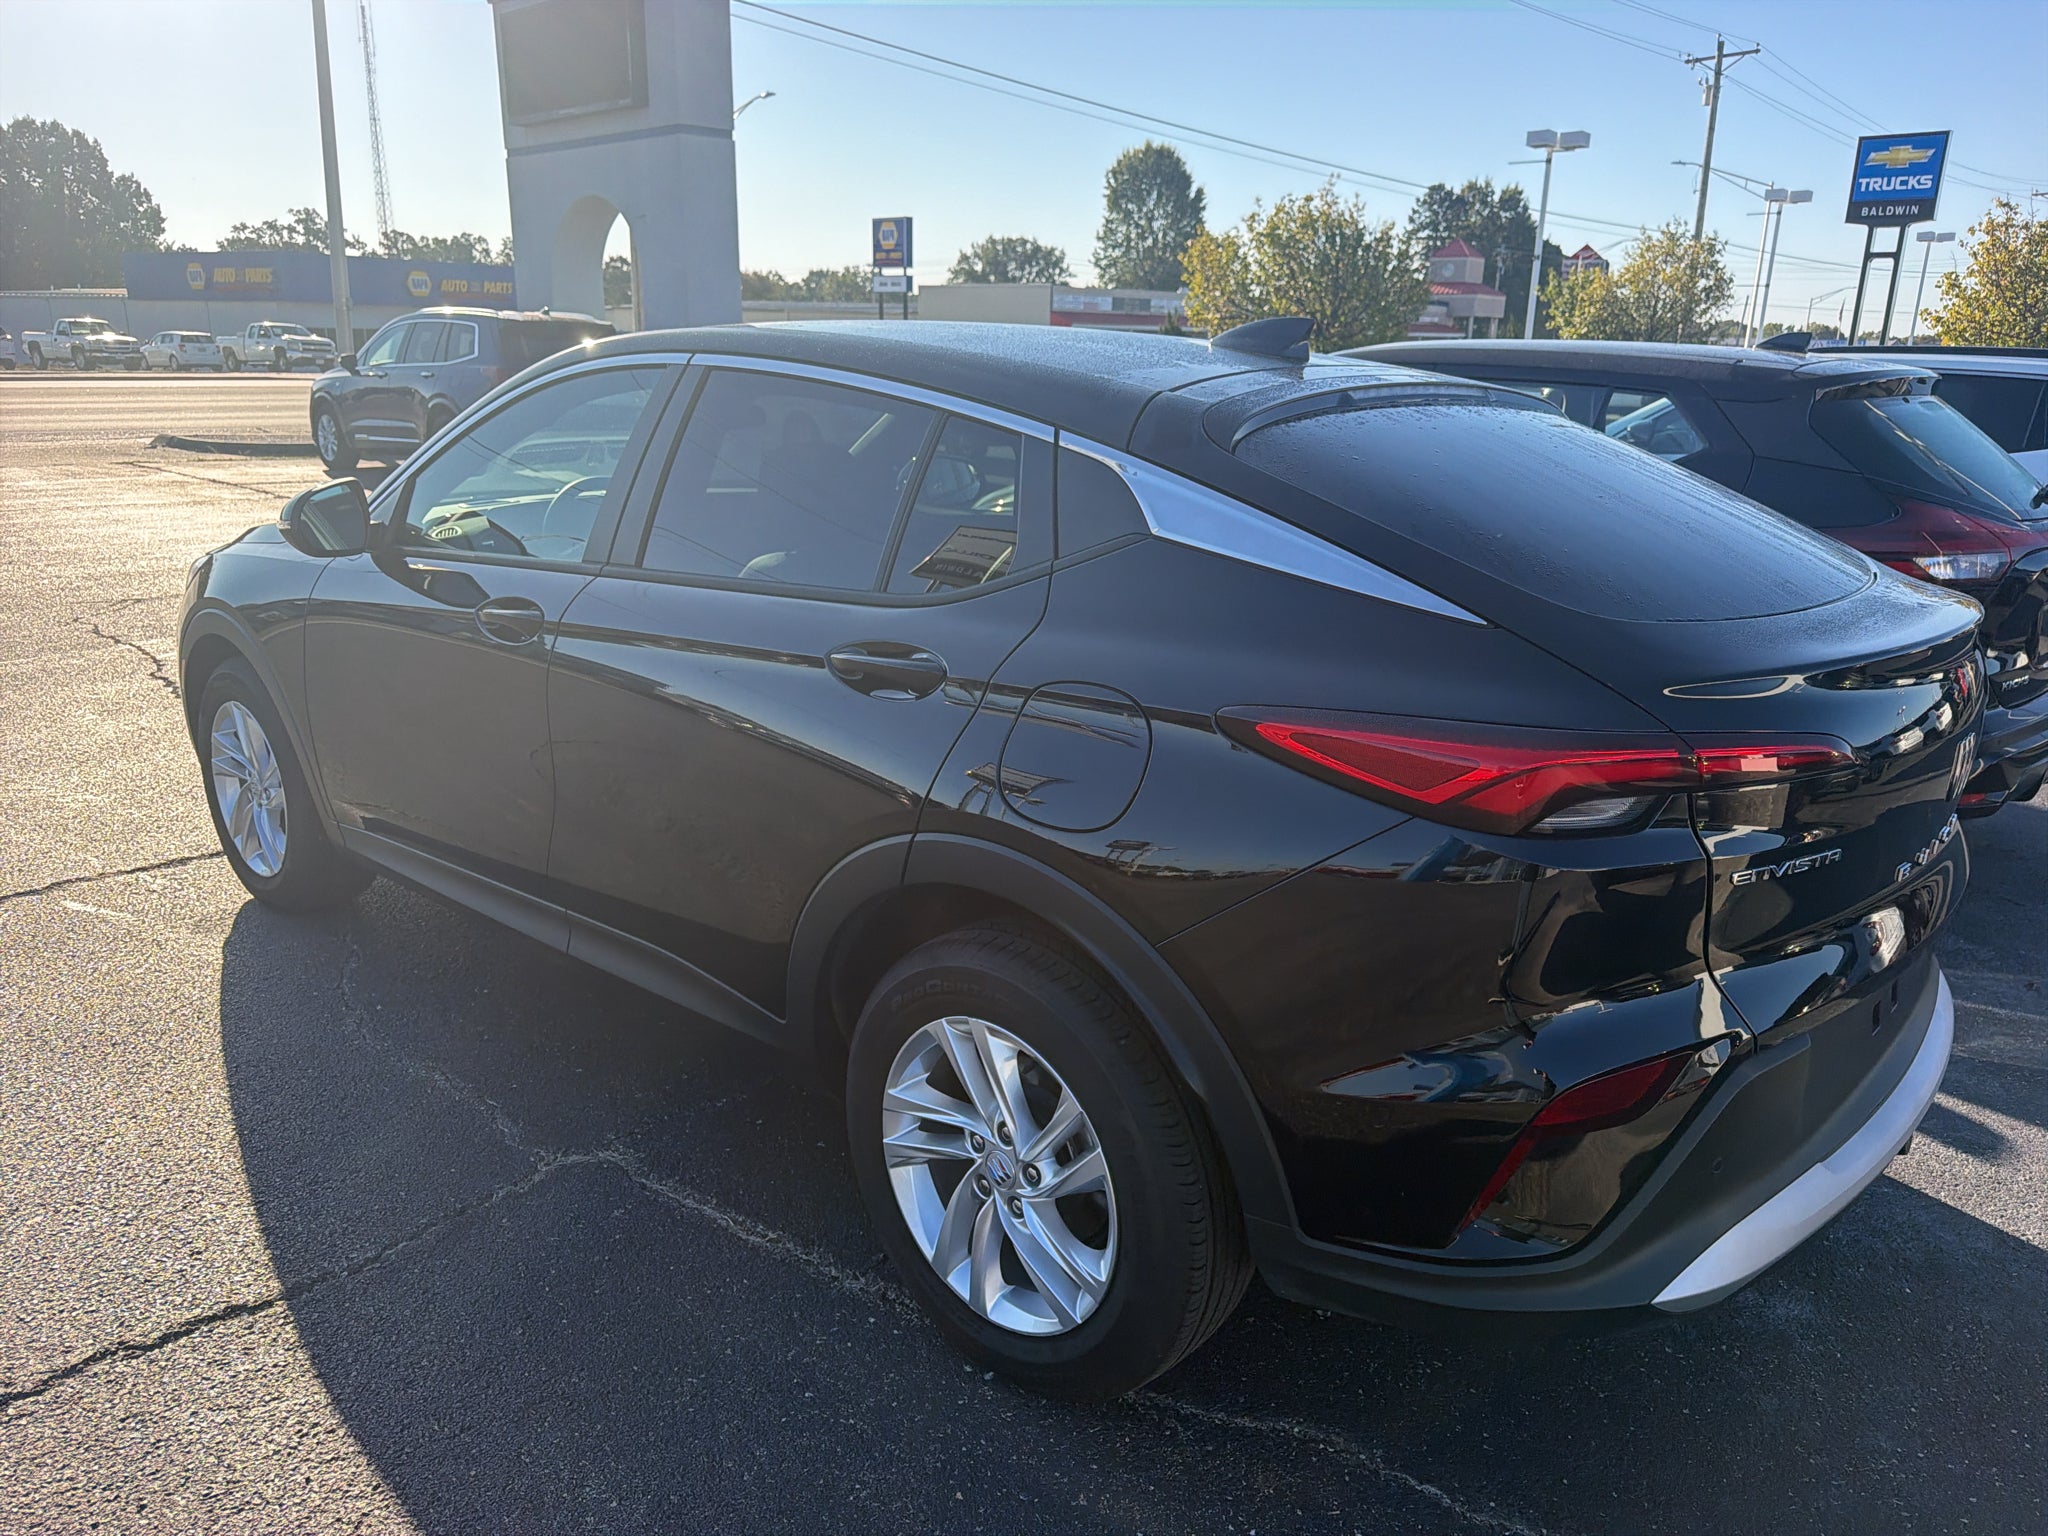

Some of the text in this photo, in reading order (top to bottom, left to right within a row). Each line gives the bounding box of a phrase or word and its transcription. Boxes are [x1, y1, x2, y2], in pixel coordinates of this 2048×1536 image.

[1858, 174, 1934, 192] TRUCKS
[1861, 205, 1920, 217] BALDWIN
[213, 267, 236, 283] AUTO
[441, 280, 468, 292] AUTO
[483, 281, 513, 294] PARTS
[1731, 848, 1842, 886] ENVISTA
